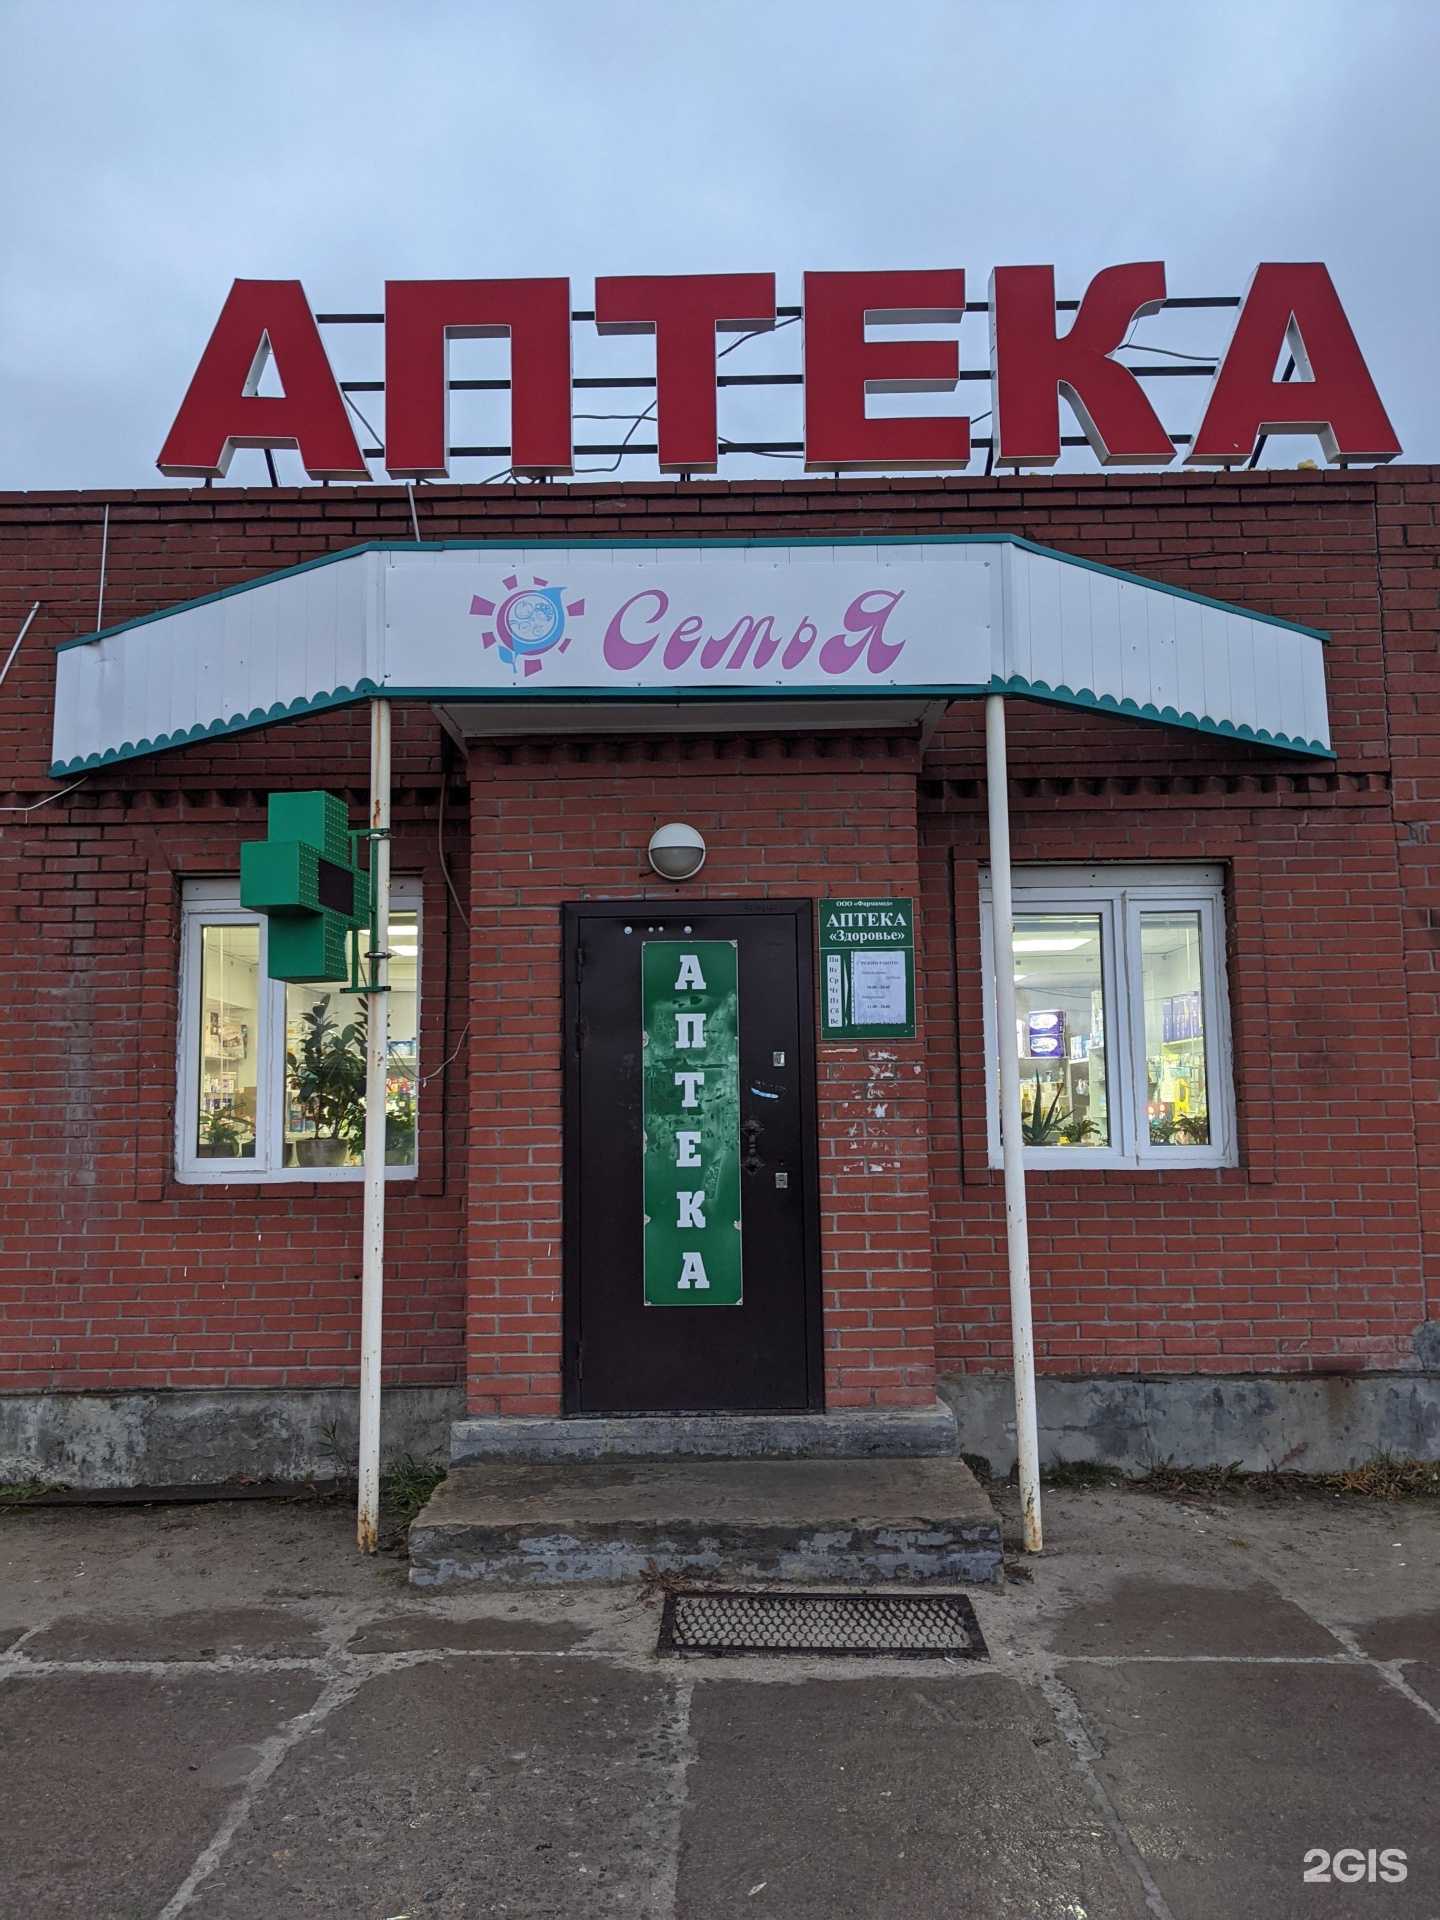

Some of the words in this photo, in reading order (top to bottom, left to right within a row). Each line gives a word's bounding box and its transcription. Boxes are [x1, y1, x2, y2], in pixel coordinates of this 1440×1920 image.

[156, 261, 1402, 482] АПТЕКА
[826, 912, 907, 928] АПТЕКА
[829, 930, 905, 943] «Здоровье»
[674, 954, 710, 1289] АПТЕКА
